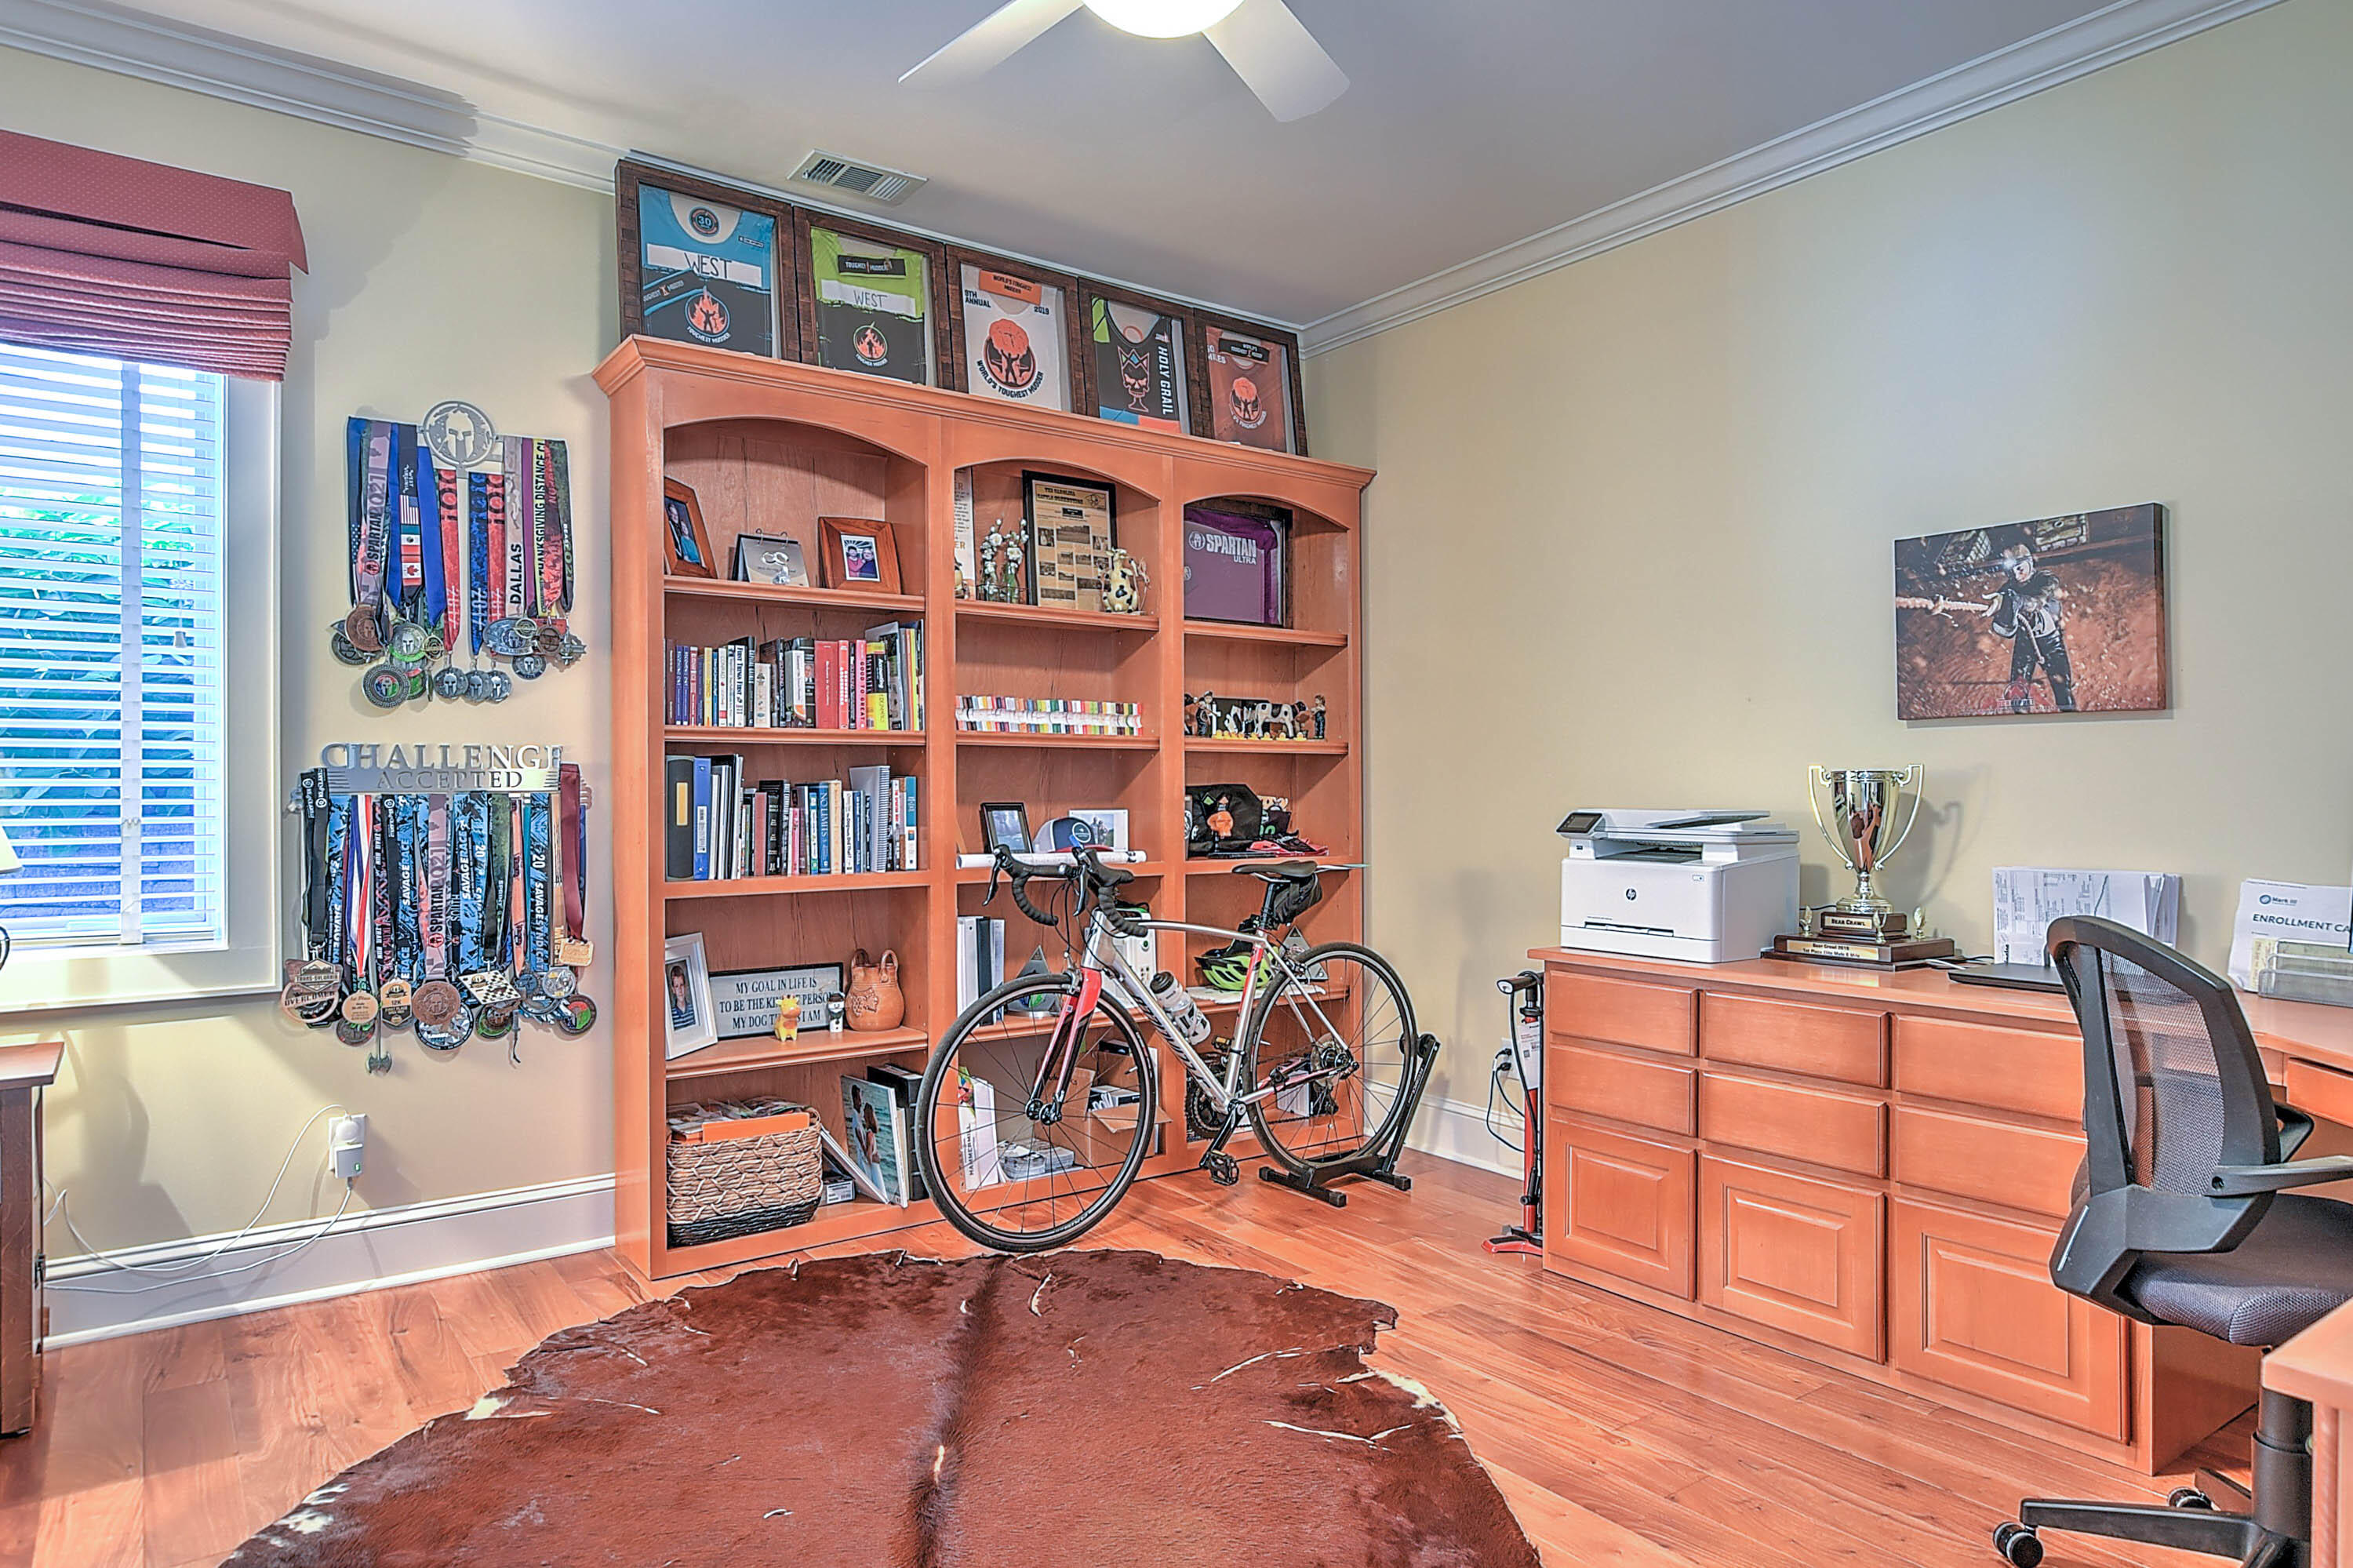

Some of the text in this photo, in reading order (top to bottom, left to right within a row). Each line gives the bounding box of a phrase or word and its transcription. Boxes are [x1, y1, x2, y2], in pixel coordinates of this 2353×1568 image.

[684, 253, 732, 279] WEST
[853, 289, 888, 308] WEST
[965, 297, 991, 307] ANNUAL
[1158, 346, 1170, 378] HOLY
[977, 360, 1044, 398] WORLD'S TOUGHEST MUDDER
[1160, 380, 1173, 415] GRAIL
[535, 454, 545, 500] DISTANCE
[366, 512, 382, 560] SPARTAN
[1206, 533, 1257, 558] SPARTAN
[1234, 555, 1257, 565] ULTRA
[510, 544, 522, 604] DALLAS
[860, 686, 865, 694] TO
[377, 769, 523, 790] ACCEPTED
[820, 792, 827, 807] NO
[401, 839, 410, 905] SAVAGERACE
[460, 831, 471, 900] SAVAGERACE
[1626, 888, 1637, 900] hp
[429, 885, 443, 933] SPARTAN
[535, 882, 544, 971] SAVAGESYNDICAT
[2253, 914, 2333, 931] ENROLLMENT
[736, 977, 817, 995] MY GOAL IN LIFE IS
[719, 1001, 732, 1013] TO
[733, 1000, 745, 1012] BE
[747, 999, 765, 1011] THE
[733, 1017, 747, 1029] MY
[748, 1015, 768, 1028] DOG
[806, 1010, 820, 1022] AM
